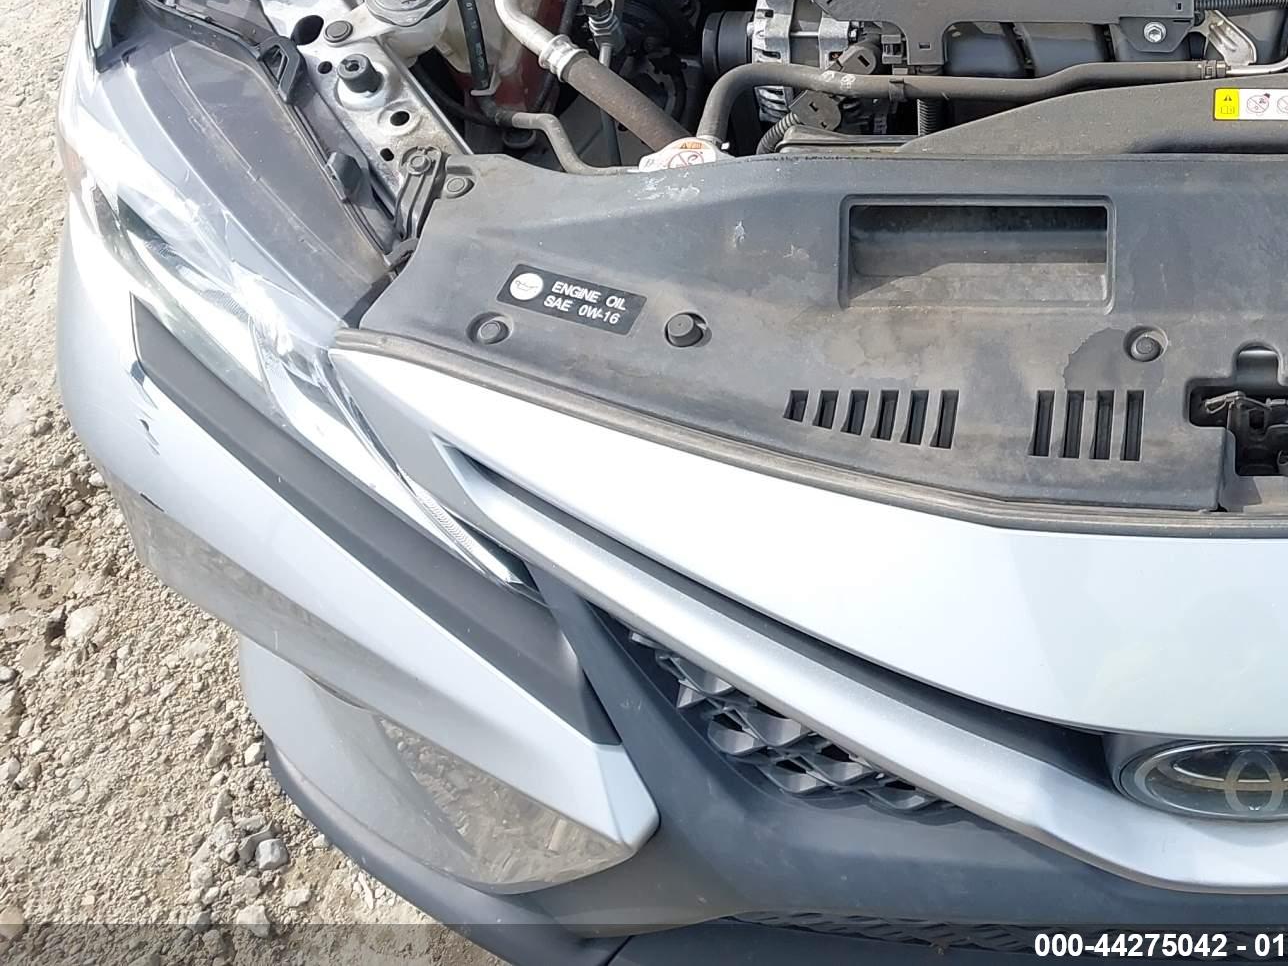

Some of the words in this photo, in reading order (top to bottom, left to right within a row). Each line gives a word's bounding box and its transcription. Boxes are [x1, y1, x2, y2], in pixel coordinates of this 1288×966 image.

[543, 295, 574, 312] SAE
[578, 304, 620, 325] 0W-16
[551, 281, 601, 303] ENGINE
[605, 295, 626, 311] OIL
